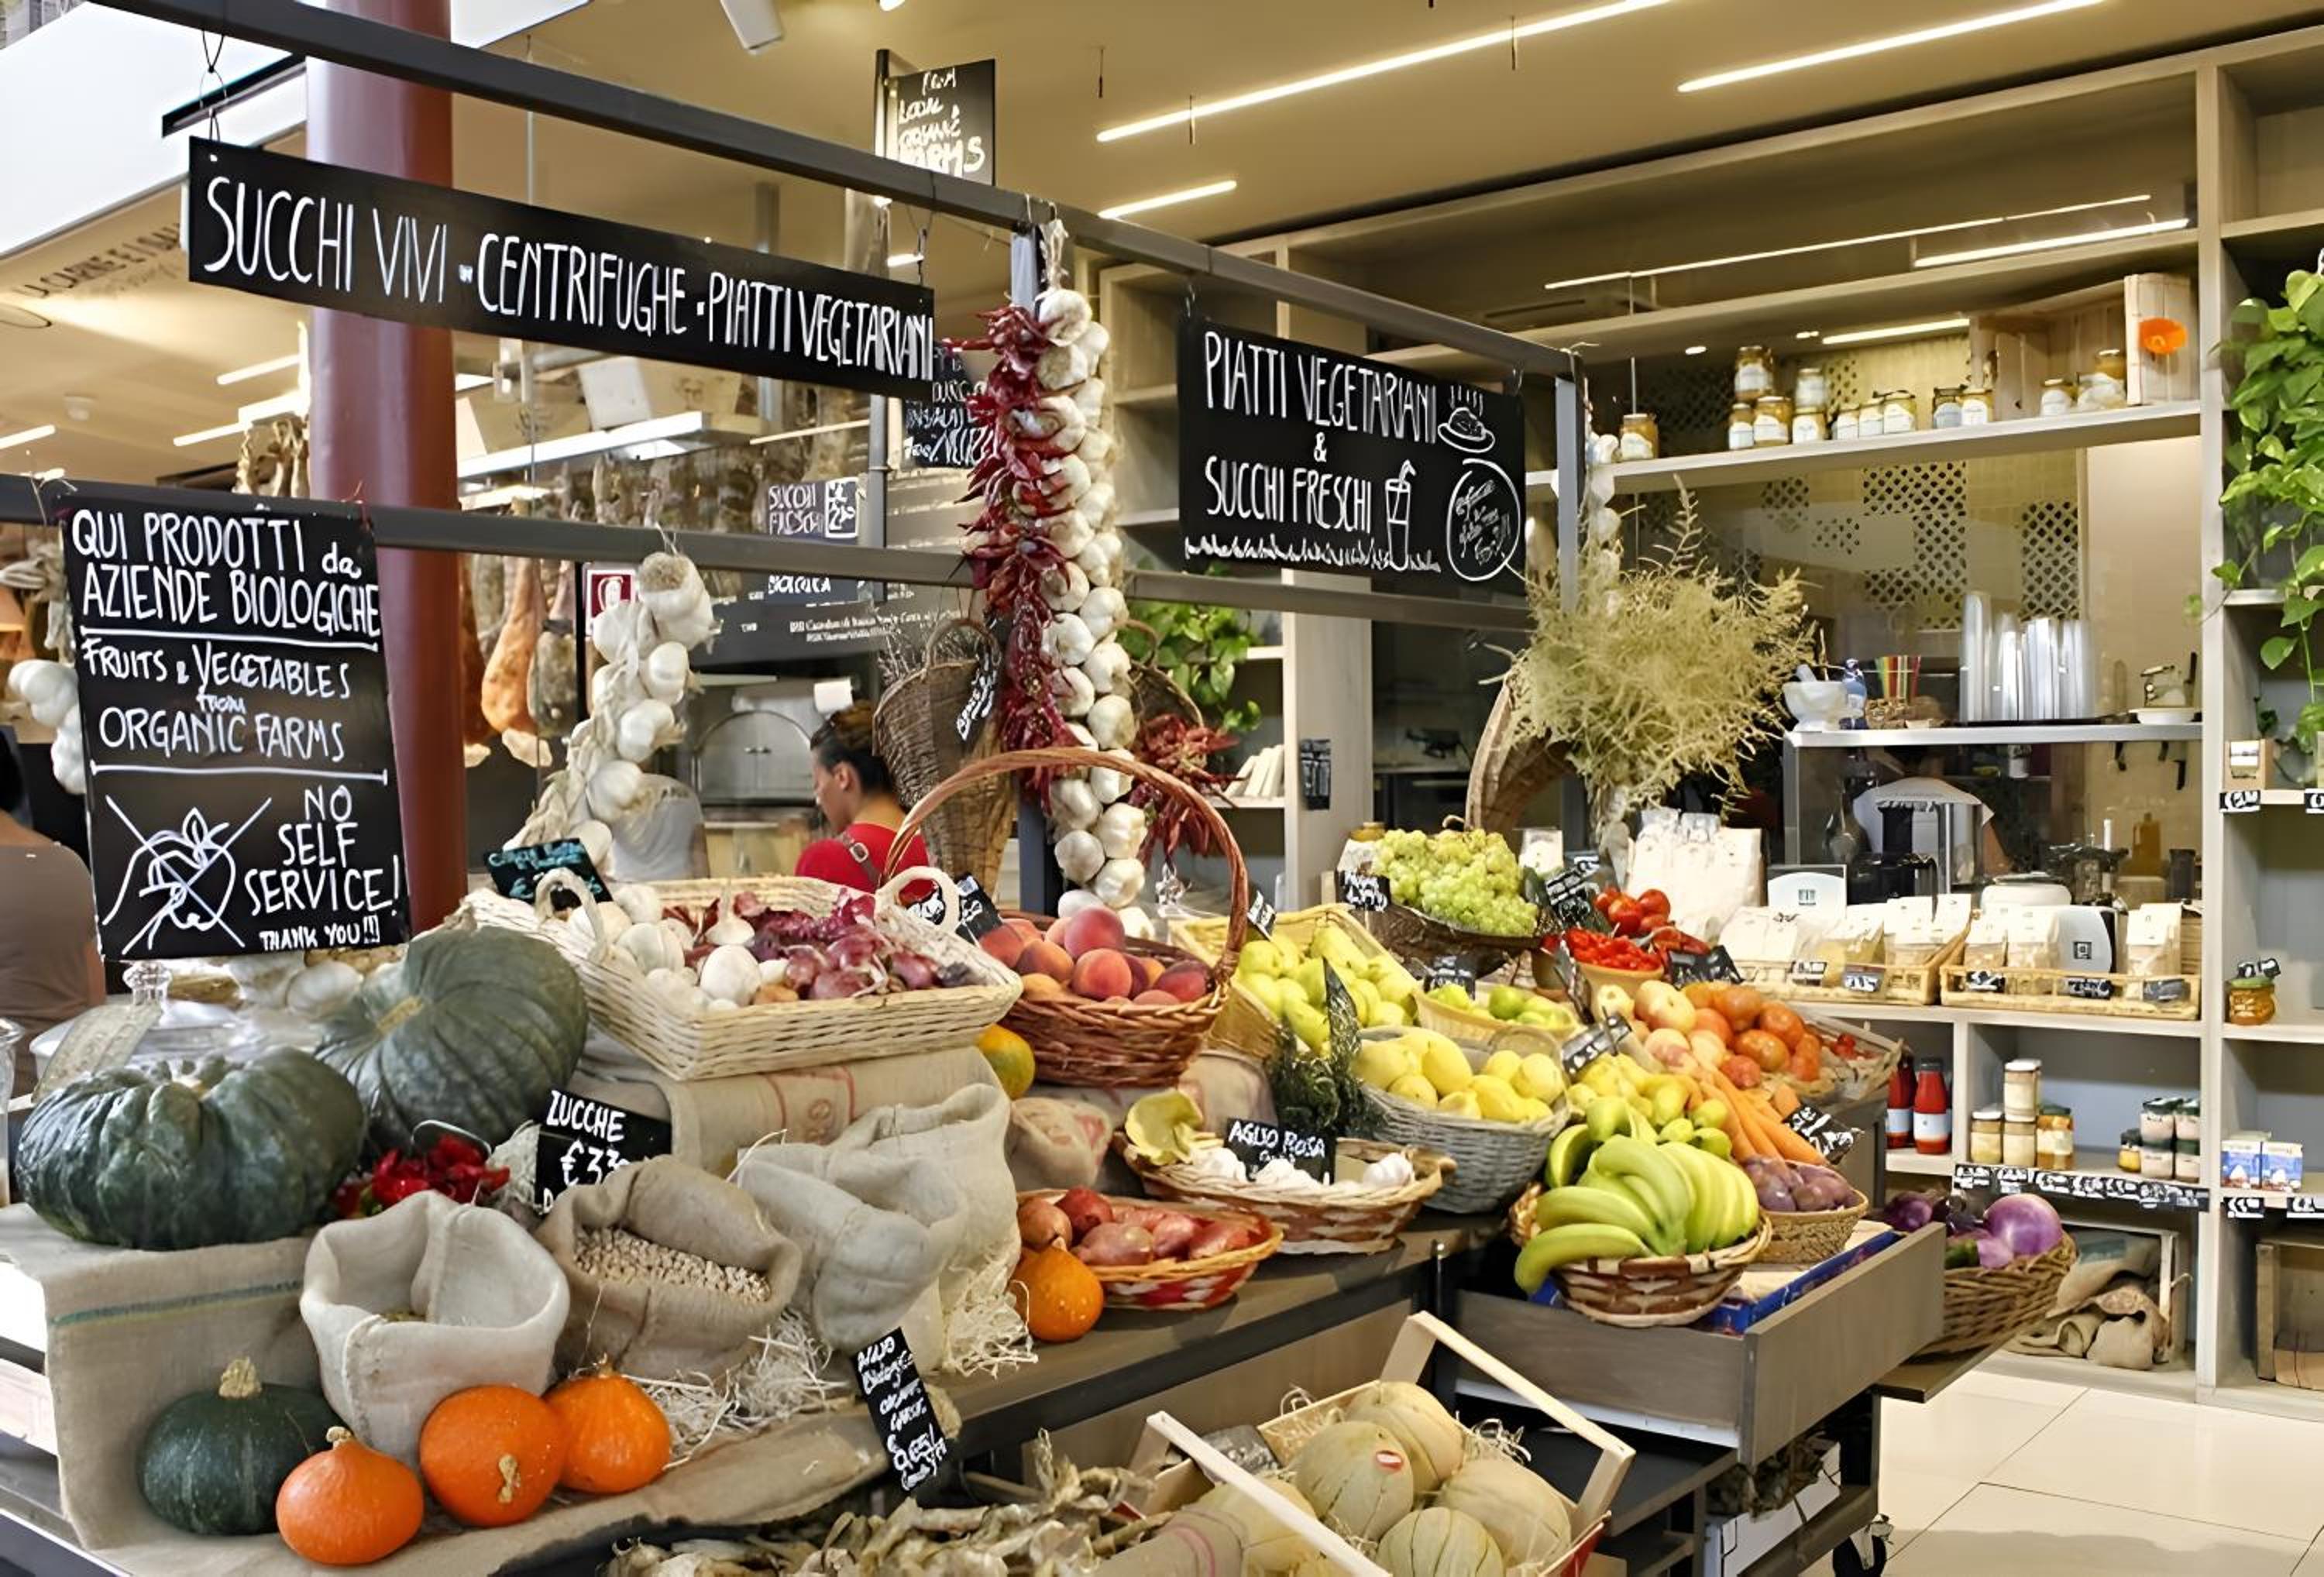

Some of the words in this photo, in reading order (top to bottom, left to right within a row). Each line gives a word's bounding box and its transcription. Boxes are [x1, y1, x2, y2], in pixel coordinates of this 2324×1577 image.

[204, 177, 353, 294] SUCCHI
[372, 207, 448, 304] VIVI
[477, 232, 687, 337] CENTRIFUGHE
[707, 272, 791, 353] PIATTI
[799, 291, 934, 380] VEGETARIANI
[1205, 331, 1287, 419] PIATTI
[1297, 354, 1438, 444] VEGETARIANI
[1313, 432, 1328, 462] &
[1205, 455, 1285, 523] SUCCHI
[1293, 466, 1372, 534] FRESCHI
[72, 509, 128, 559] QUI
[144, 512, 305, 572] PRODOTTI
[321, 541, 362, 579] da
[82, 562, 218, 624] AZIENDE
[230, 570, 381, 637] BIOLOGICHE
[81, 637, 168, 682] FRUITS
[191, 640, 351, 699] VEGETABLES
[98, 706, 246, 758] ORGANIC
[254, 713, 346, 762] FARMS
[304, 785, 353, 822] NO
[278, 822, 359, 868] SELF
[244, 854, 400, 917] SERVICE!
[259, 925, 319, 951] THANK
[546, 1090, 627, 1142] ZUCCHE
[1281, 1131, 1325, 1158] ROSA
